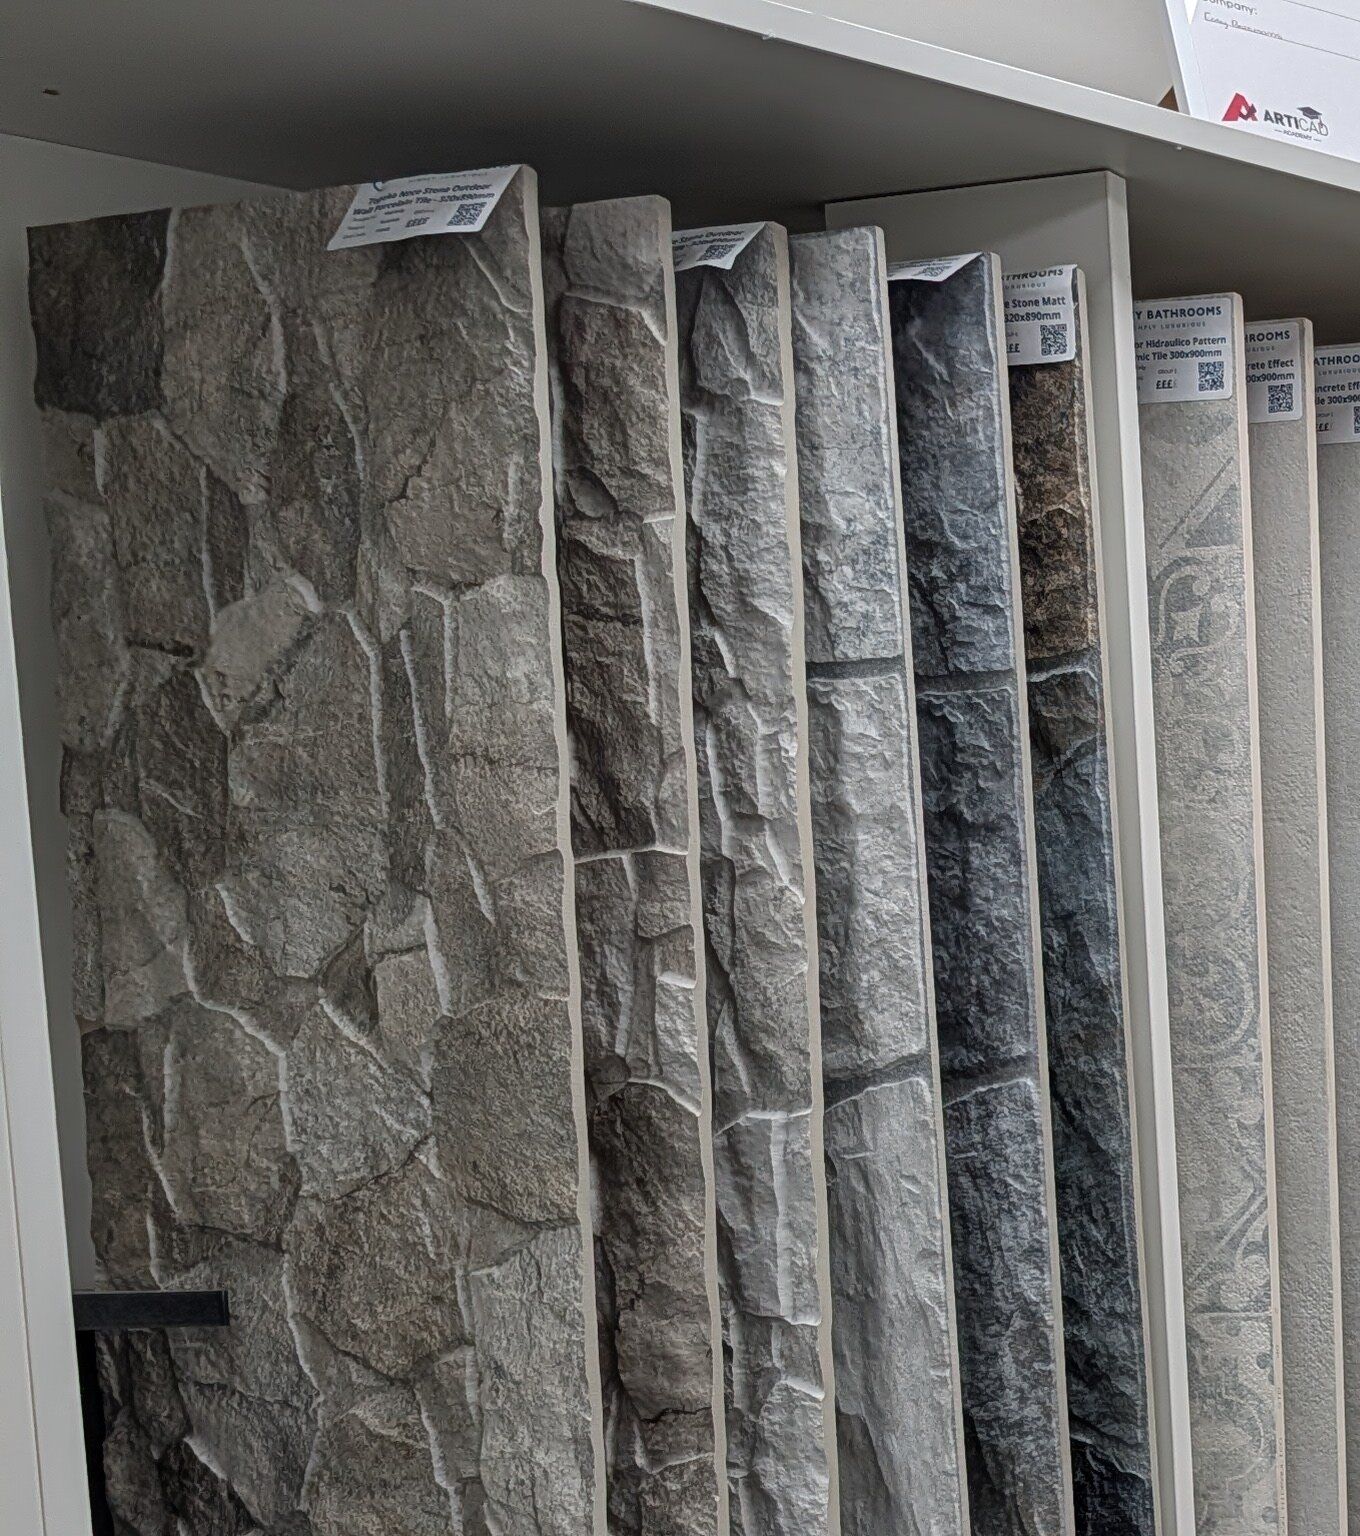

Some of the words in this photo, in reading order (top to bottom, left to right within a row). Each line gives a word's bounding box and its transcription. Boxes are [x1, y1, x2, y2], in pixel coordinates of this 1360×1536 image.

[1263, 108, 1329, 137] ARTICAD
[1012, 299, 1039, 308] Stone
[1042, 296, 1066, 306] Matt
[1147, 306, 1222, 319] BATHROOMS
[1146, 337, 1191, 348] Hidraulico
[1193, 336, 1227, 346] Pattern
[1152, 351, 1168, 360] Tile
[1169, 349, 1222, 359] 300x900mm
[1268, 359, 1294, 369] Effect
